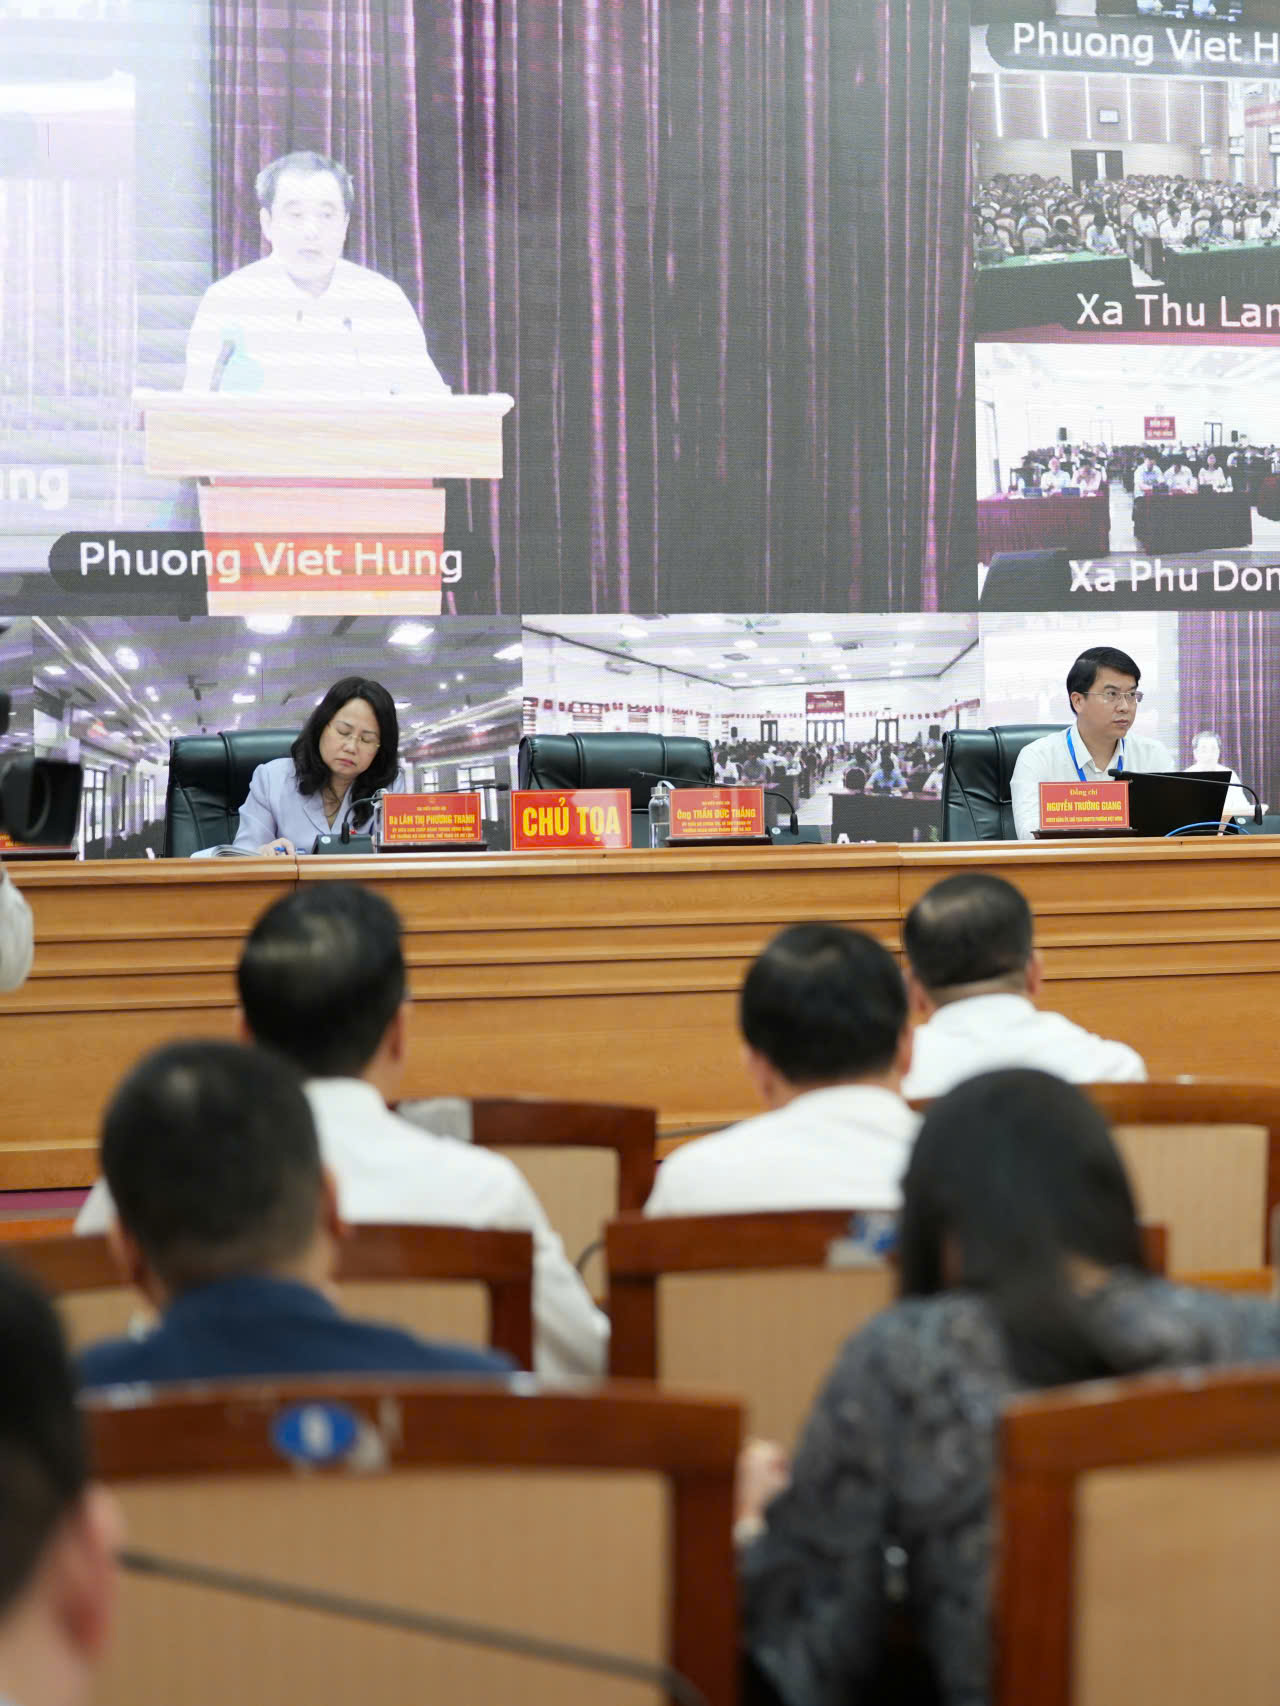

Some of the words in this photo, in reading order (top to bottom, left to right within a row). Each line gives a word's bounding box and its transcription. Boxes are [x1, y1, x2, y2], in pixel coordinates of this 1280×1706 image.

[1013, 21, 1154, 66] Phuong
[1166, 28, 1243, 63] Viet
[1076, 293, 1123, 326] Xa
[1135, 293, 1206, 326] Thu
[79, 540, 242, 584] Phuong
[253, 542, 342, 577] Viet
[355, 542, 463, 584] Hung
[1069, 559, 1116, 592] Xa
[1130, 559, 1198, 592] Phu
[522, 796, 570, 837] CHỦ
[576, 806, 622, 842] TỌA
[1101, 801, 1122, 811] GIANG
